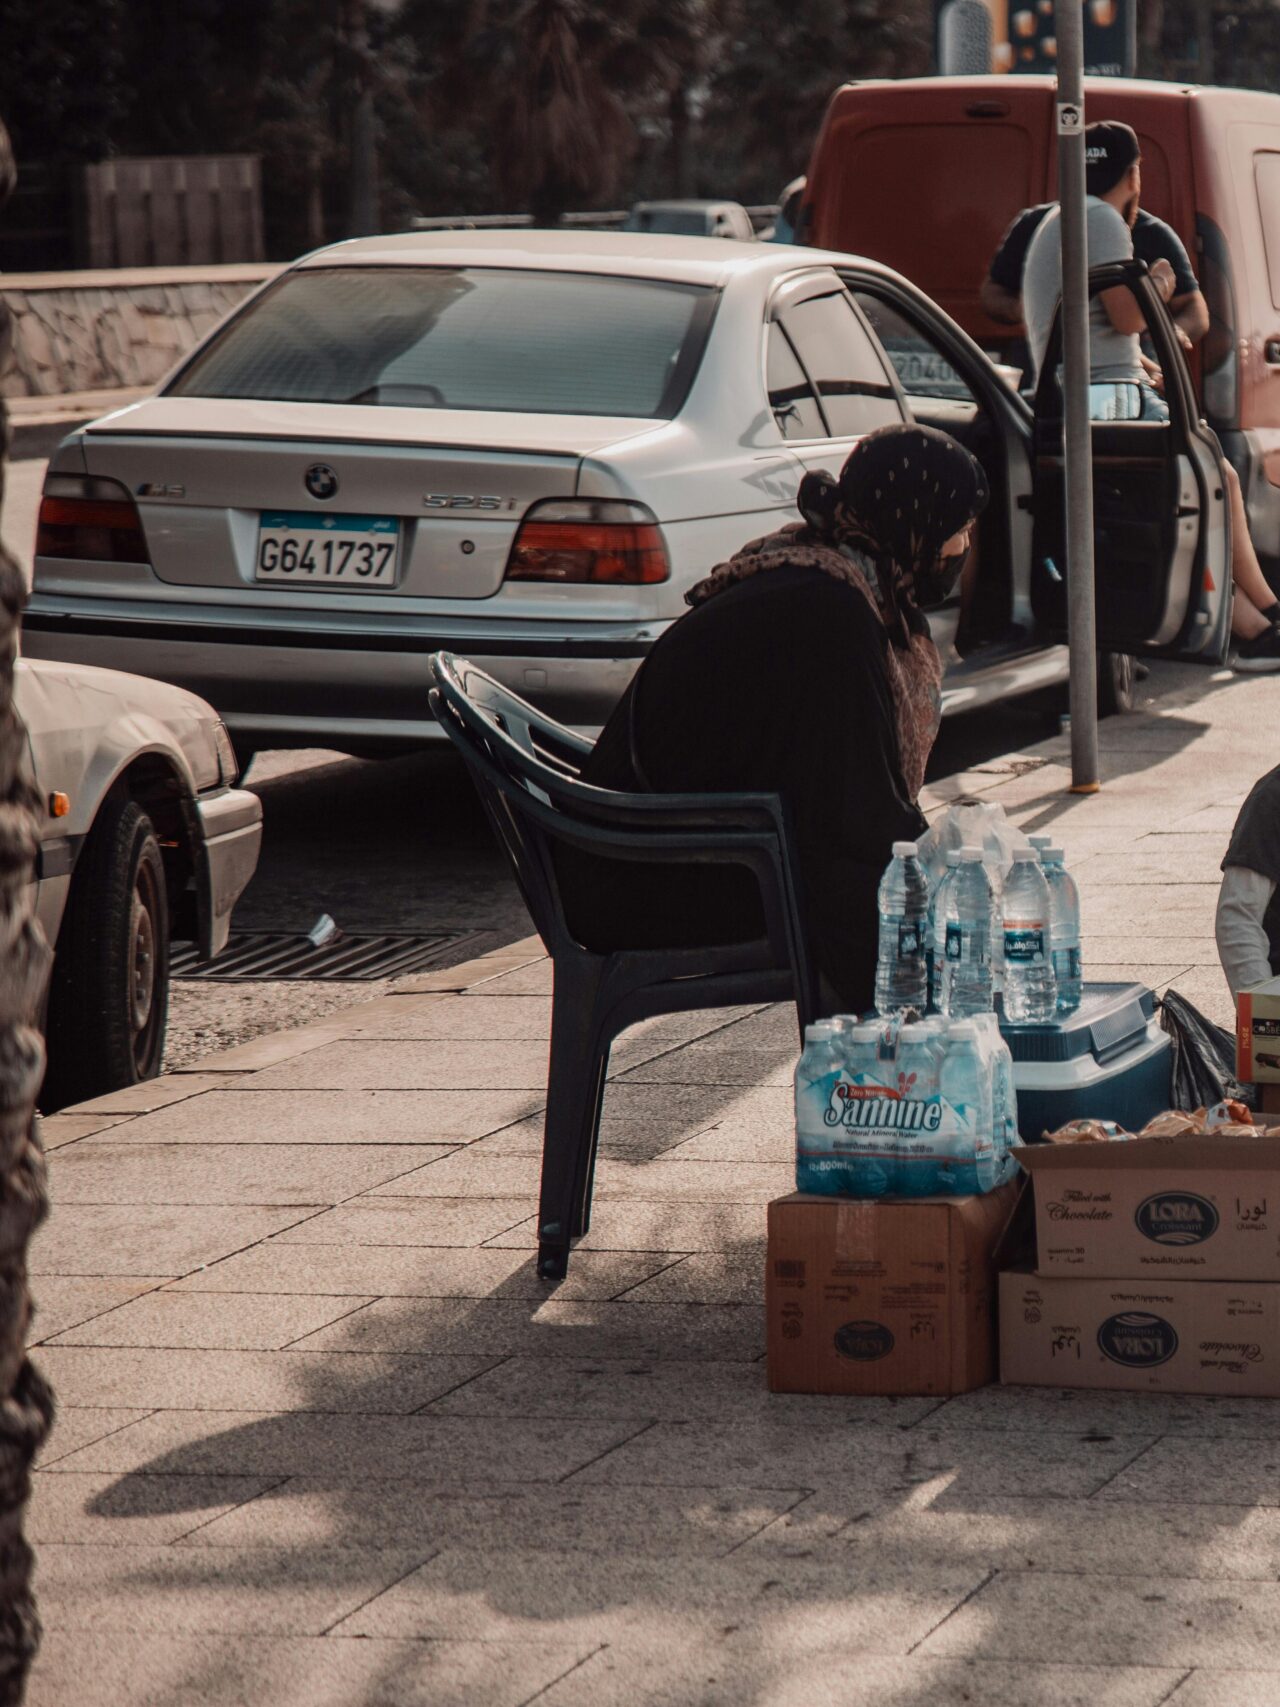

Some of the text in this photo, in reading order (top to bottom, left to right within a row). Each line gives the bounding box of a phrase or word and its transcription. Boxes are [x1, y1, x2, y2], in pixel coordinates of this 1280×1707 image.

[260, 538, 395, 577] G641737
[823, 1082, 942, 1132] Sannine
[845, 1129, 918, 1139] Natural Mineral Water
[1062, 1189, 1112, 1202] Filled with
[1046, 1202, 1113, 1221] Chocolate
[1149, 1203, 1205, 1222] LORA
[1236, 1197, 1267, 1221] لورا
[1151, 1222, 1202, 1231] Croissant
[1052, 1335, 1081, 1360] لورا
[1112, 1336, 1164, 1356] LORA
[1199, 1342, 1264, 1363] Chocolate
